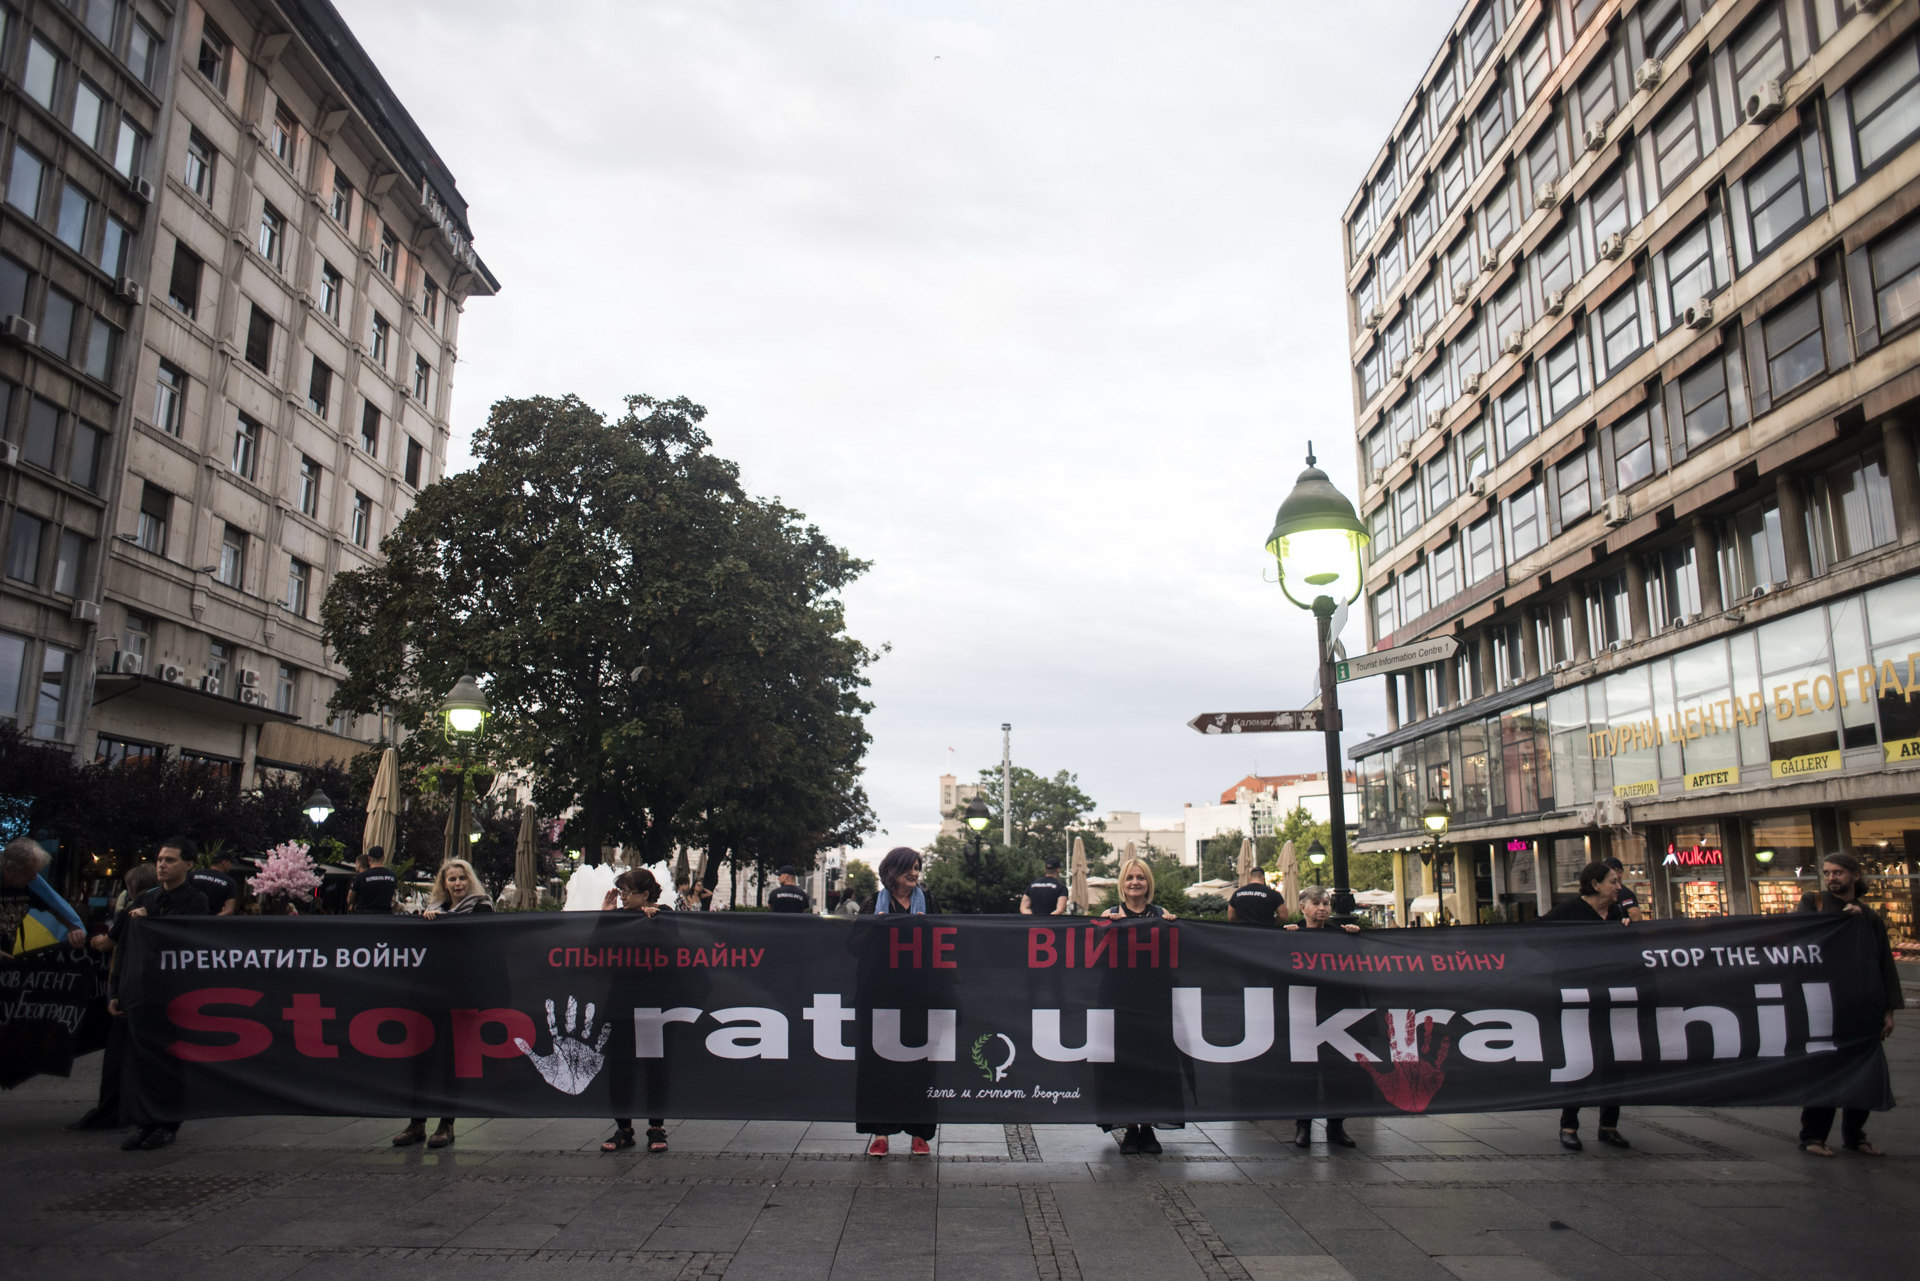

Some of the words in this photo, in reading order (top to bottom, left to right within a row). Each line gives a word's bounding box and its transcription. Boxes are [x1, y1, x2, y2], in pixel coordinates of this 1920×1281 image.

[1356, 660, 1377, 672] Tourist
[1378, 651, 1417, 667] Information
[1418, 645, 1443, 658] Centre
[1445, 642, 1449, 651] 1
[1667, 691, 1764, 748] ЦЕНТАР
[1780, 755, 1829, 774] GALLERY
[1619, 783, 1655, 797] ГАЛЕРИЈА
[1692, 771, 1729, 788] АРТГЕТ
[160, 948, 328, 971] ПРЕКРАТИТЬ
[335, 944, 428, 969] ВОЙНУ
[548, 946, 669, 972] СПЫНІЦЬ
[676, 943, 766, 969] ВАЙНУ
[889, 926, 958, 970] НЕ
[1028, 919, 1180, 969] ВІЙНІ
[1642, 948, 1706, 969] STOP
[1710, 946, 1760, 967] THE
[1763, 944, 1823, 966] WAR
[1291, 951, 1425, 973] ЗУПИНИТИ
[1432, 949, 1506, 973] ВІЙНУ
[165, 988, 537, 1078] Stop
[634, 993, 957, 1062] ratu
[1031, 1009, 1116, 1063] u
[1171, 983, 1838, 1083] Ukrajini!
[926, 1086, 956, 1099] žene
[961, 1088, 972, 1099] u
[976, 1087, 1026, 1099] crnom
[1032, 1085, 1081, 1104] beograd
